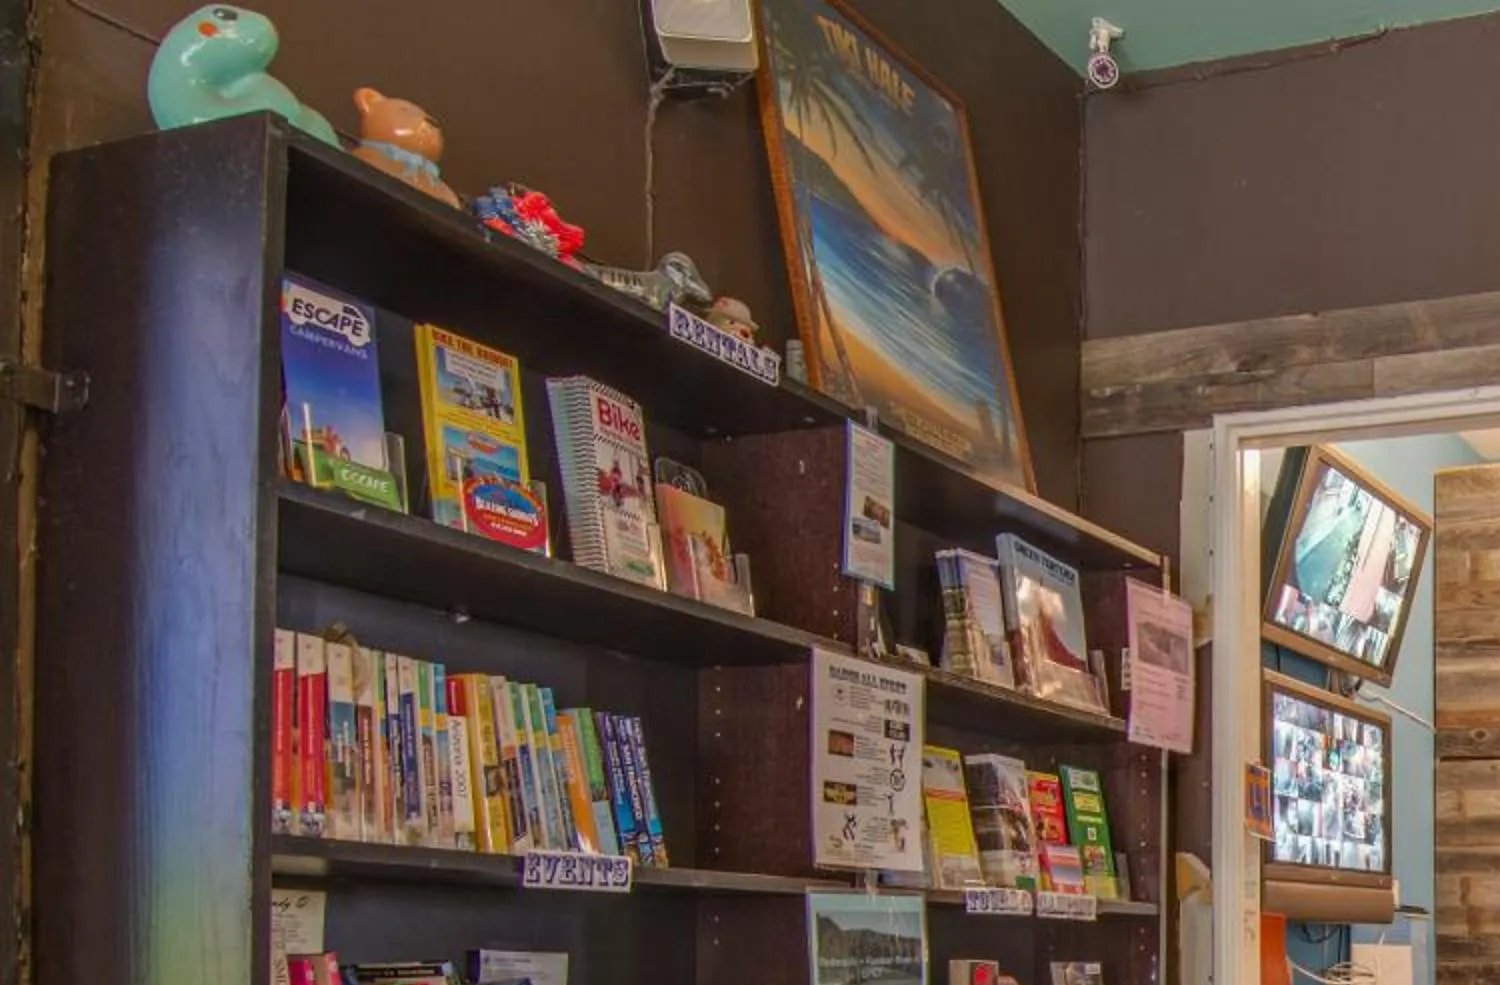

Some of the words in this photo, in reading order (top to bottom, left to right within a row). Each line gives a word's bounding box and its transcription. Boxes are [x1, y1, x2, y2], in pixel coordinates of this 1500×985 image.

[291, 298, 365, 337] ESCAPE
[674, 310, 778, 384] RENTALS
[597, 398, 642, 440] Bike
[455, 769, 469, 798] 2007
[525, 852, 629, 887] EVENTS
